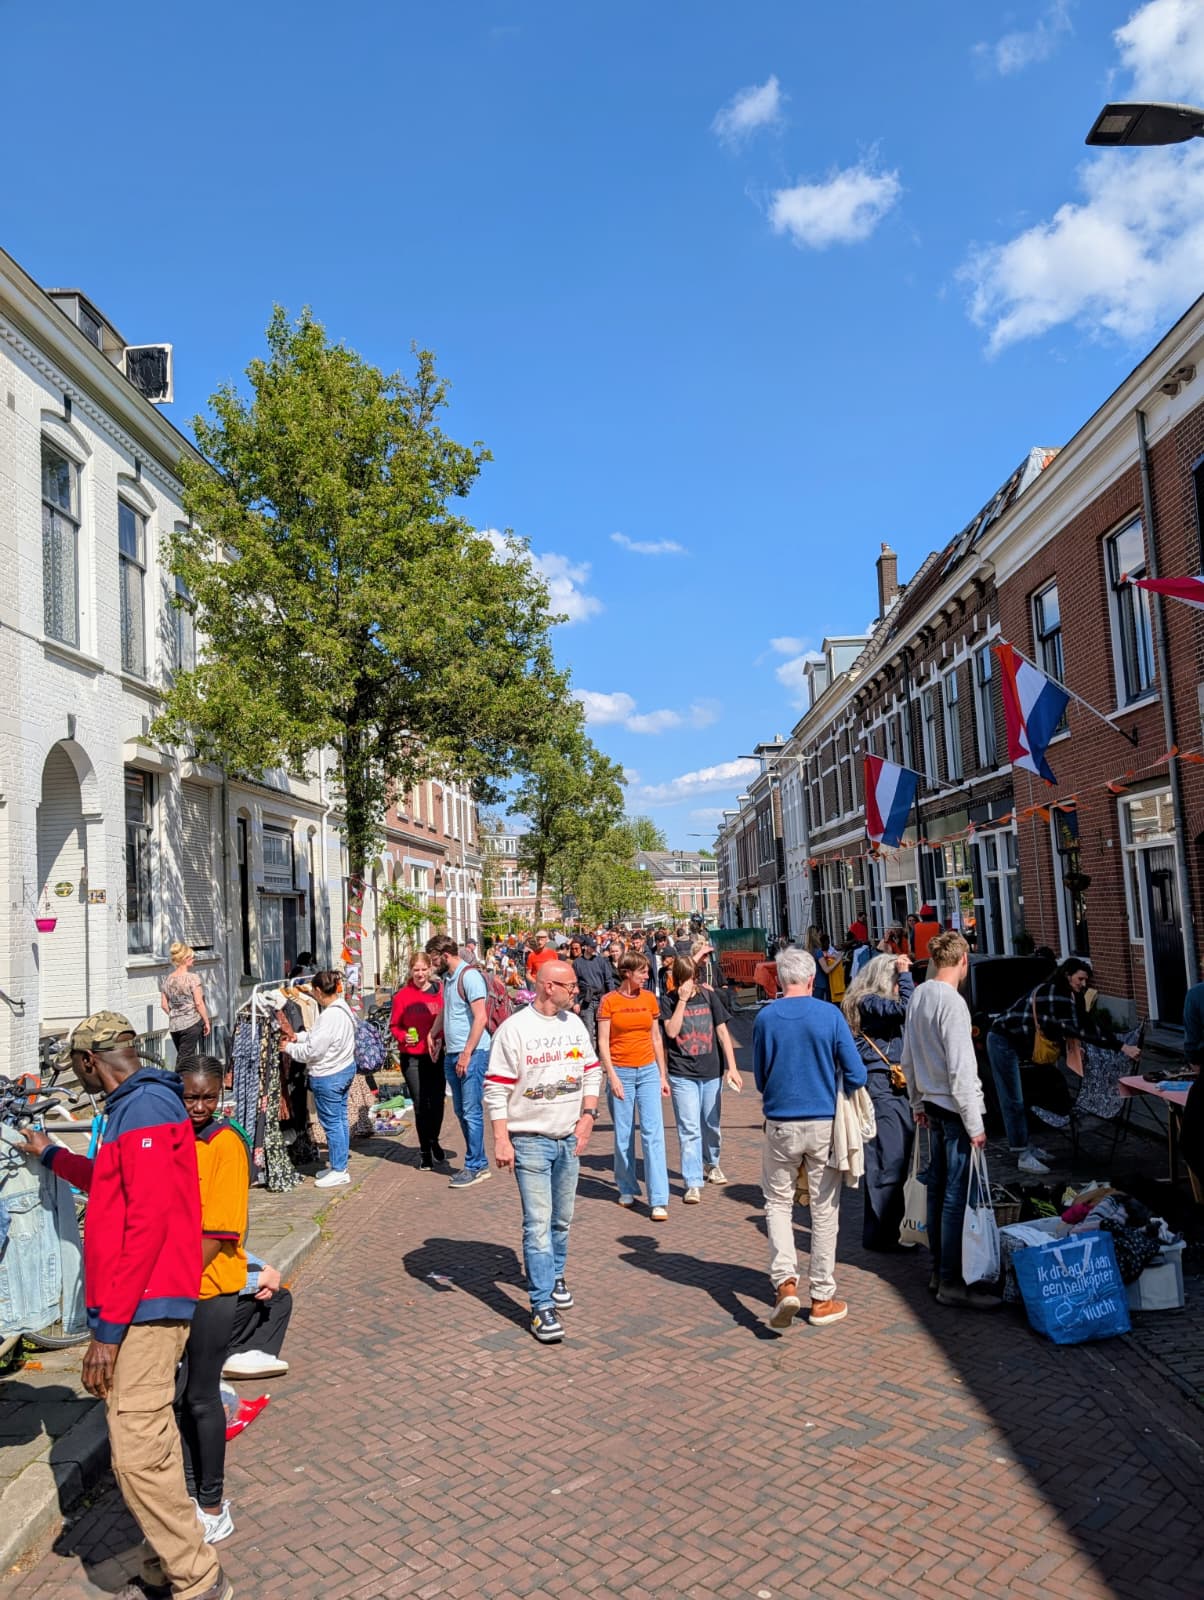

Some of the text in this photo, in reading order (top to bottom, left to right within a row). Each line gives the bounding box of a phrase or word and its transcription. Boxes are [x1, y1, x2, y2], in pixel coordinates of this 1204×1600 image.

[1095, 1256, 1111, 1270] aan
[1042, 1282, 1063, 1297] een
[1083, 1298, 1117, 1321] vlucht
